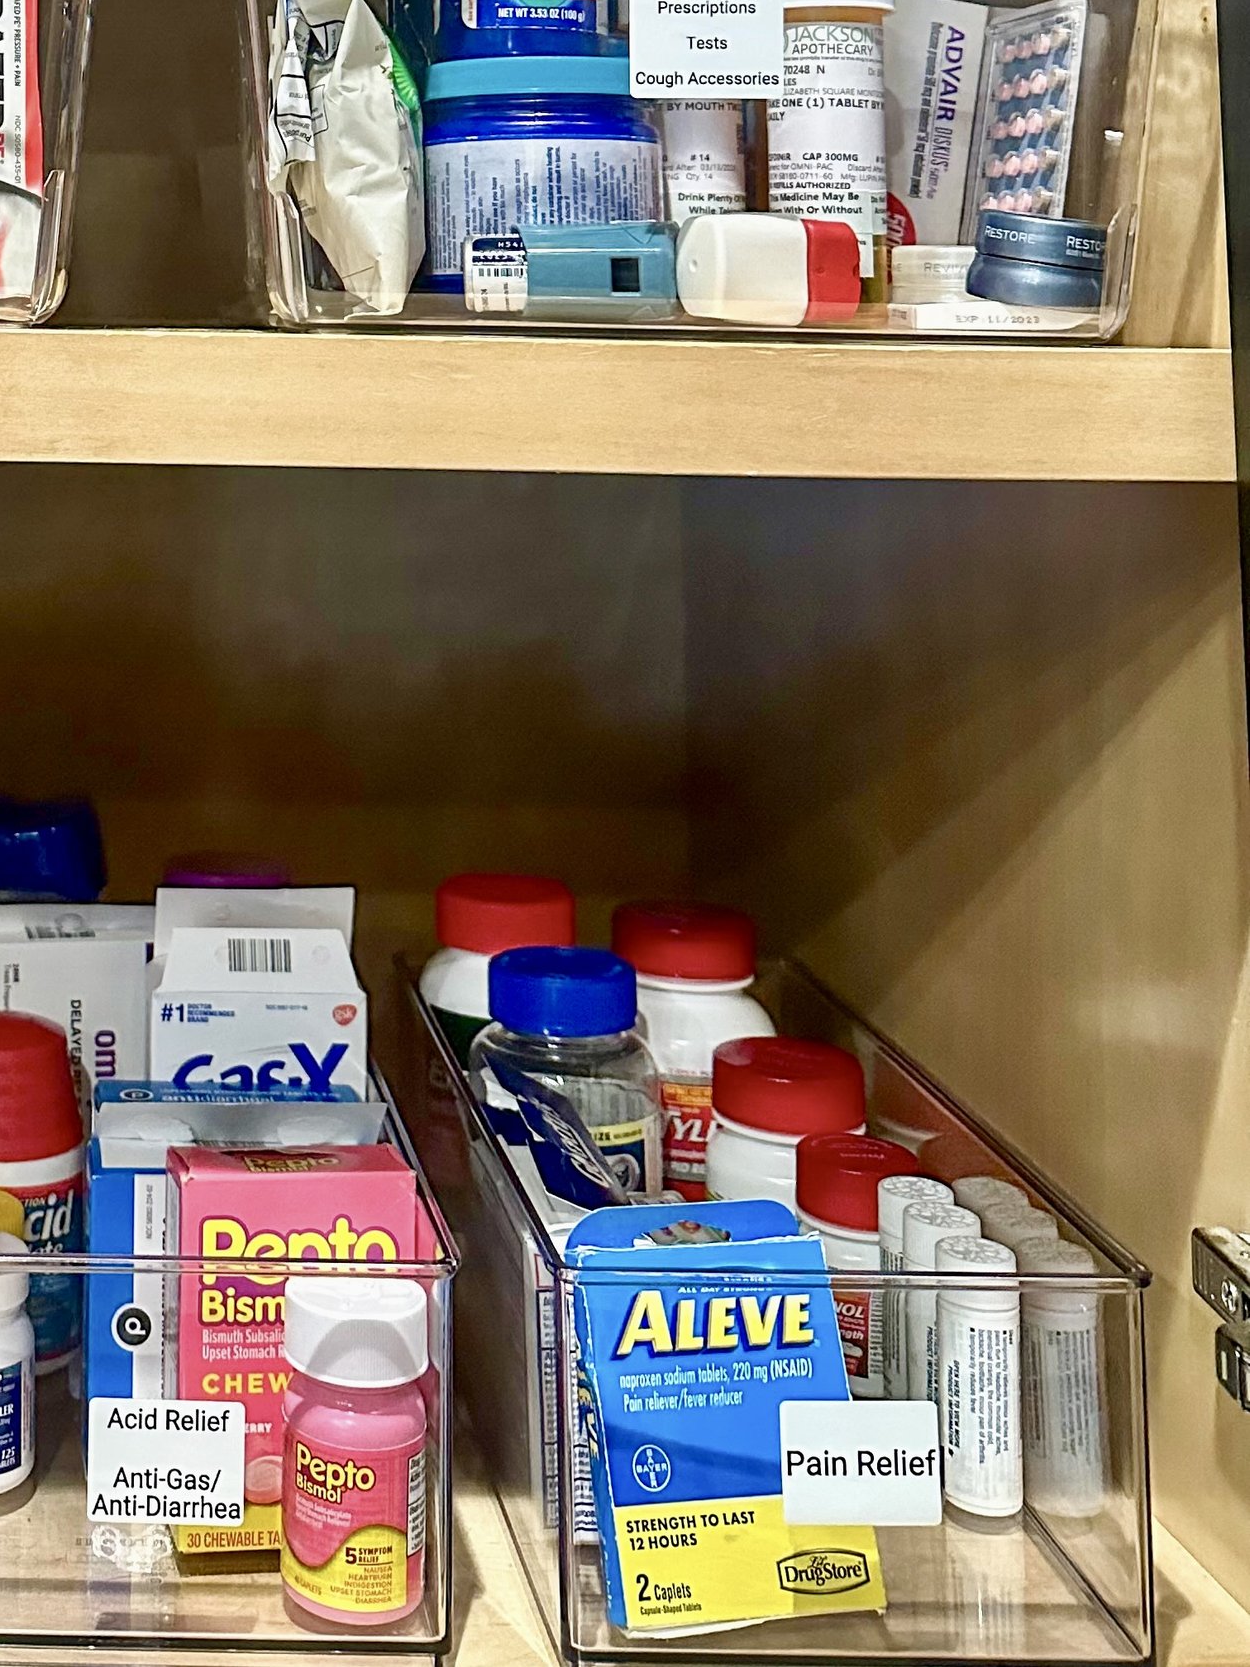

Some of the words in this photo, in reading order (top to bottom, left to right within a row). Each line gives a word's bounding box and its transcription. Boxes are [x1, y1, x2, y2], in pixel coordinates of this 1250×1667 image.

[497, 7, 514, 18] NET
[515, 7, 528, 18] WT
[657, 1, 757, 17] Prescriptions
[686, 36, 729, 50] Tests
[791, 25, 874, 44] JACKSON
[792, 43, 874, 56] APOTHECARY
[635, 71, 684, 88] Cough
[688, 71, 780, 85] Accessories
[937, 25, 965, 122] ADVAIR
[667, 101, 681, 111] BY
[685, 102, 723, 111] MOUTH
[781, 97, 803, 108] ONE
[829, 98, 869, 109] TABLET
[802, 152, 822, 162] CAP
[825, 153, 859, 162] 300MG
[795, 182, 851, 190] AUTHORIZED
[677, 192, 704, 202] Drink
[780, 192, 820, 202] Medicine
[822, 192, 846, 203] May
[848, 192, 860, 201] Be
[806, 206, 820, 215] Or
[822, 205, 864, 215] Without
[985, 224, 1037, 245] RESTORE
[160, 1003, 186, 1023] #1
[201, 1216, 398, 1286] Pepto
[616, 1289, 816, 1356] ALEVE
[201, 1329, 244, 1344] Bismuth
[201, 1344, 232, 1362] Upset
[233, 1344, 277, 1360] Stomach
[619, 1368, 662, 1390] naproxen
[663, 1364, 697, 1385] sodium
[698, 1363, 731, 1384] tablets,
[732, 1362, 752, 1381] 220
[753, 1363, 769, 1383] mg
[770, 1357, 814, 1381] (NSAID)
[201, 1372, 295, 1395] CHEW
[623, 1394, 643, 1413] Pain
[644, 1388, 708, 1412] reliever/fever
[709, 1387, 744, 1407] reducer
[106, 1407, 158, 1430] Acid
[164, 1409, 231, 1432] Relief
[1, 1446, 16, 1460] 125
[786, 1451, 848, 1477] Pain
[857, 1448, 938, 1477] Relief
[296, 1442, 376, 1491] Pepto
[636, 1463, 668, 1473] BAYER
[112, 1466, 222, 1493] Anti-Gas/
[296, 1472, 343, 1504] Bismol
[91, 1494, 242, 1520] Anti-Diarrhea
[625, 1515, 697, 1535] STRENGTH
[699, 1512, 721, 1529] TO
[722, 1509, 757, 1528] LAST
[186, 1532, 202, 1549] 30
[203, 1531, 261, 1548] CHEWABLE
[629, 1536, 645, 1552] 12
[647, 1532, 699, 1551] HOURS
[345, 1546, 358, 1565] 5
[358, 1545, 394, 1556] SYMPTOM
[358, 1556, 380, 1564] RELIEF
[784, 1562, 863, 1587] DrugStore
[635, 1572, 653, 1604] 2
[653, 1581, 693, 1603] Caplets
